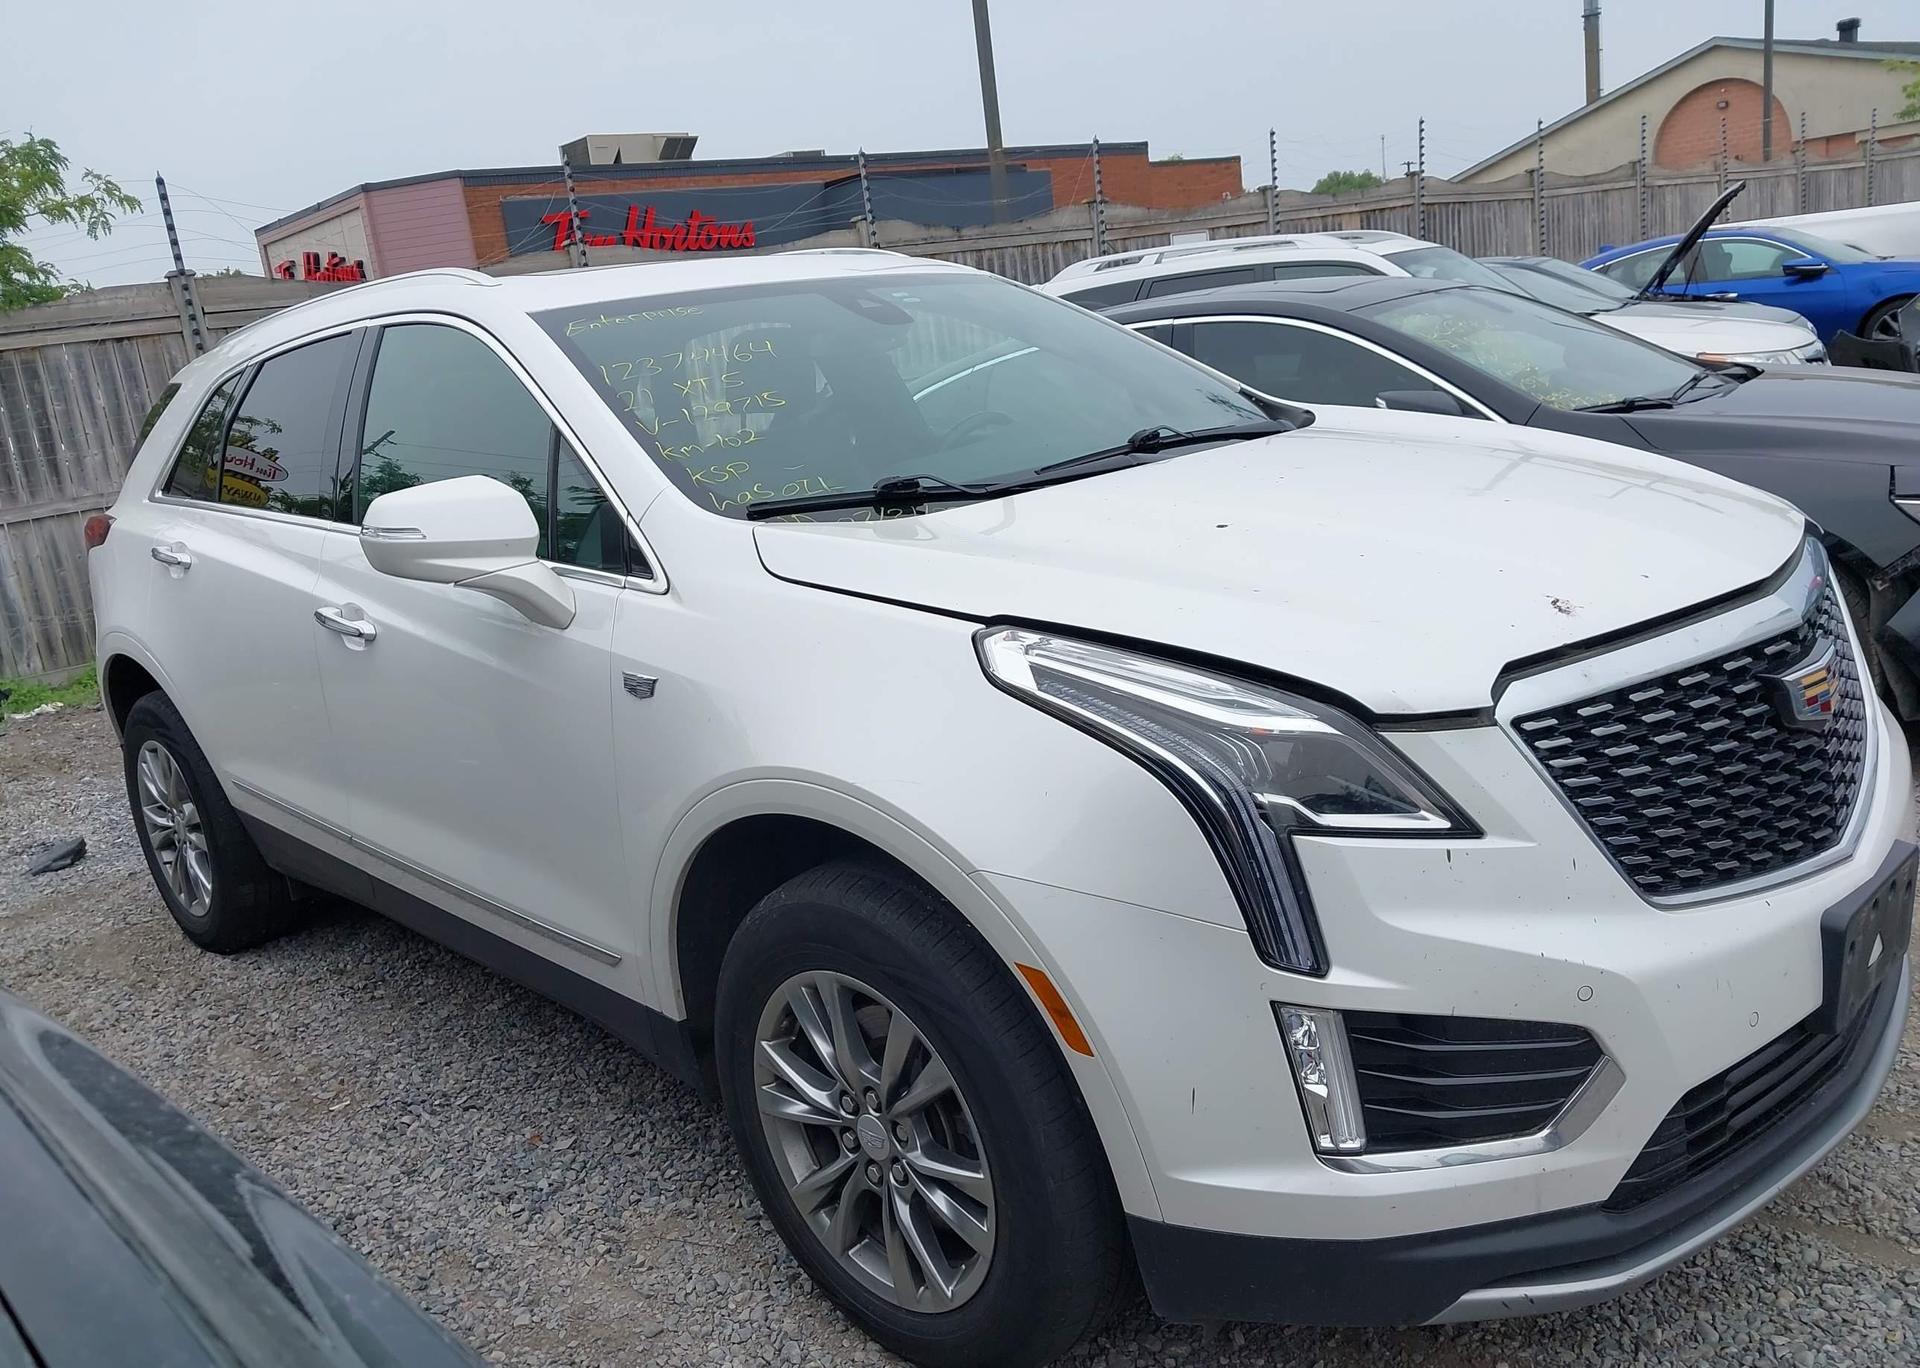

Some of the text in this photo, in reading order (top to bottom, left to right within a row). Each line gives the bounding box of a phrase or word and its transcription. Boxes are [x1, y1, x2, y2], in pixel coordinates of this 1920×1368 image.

[623, 203, 756, 251] Hortons
[566, 305, 704, 337] Enterprise
[686, 461, 750, 488] KSP
